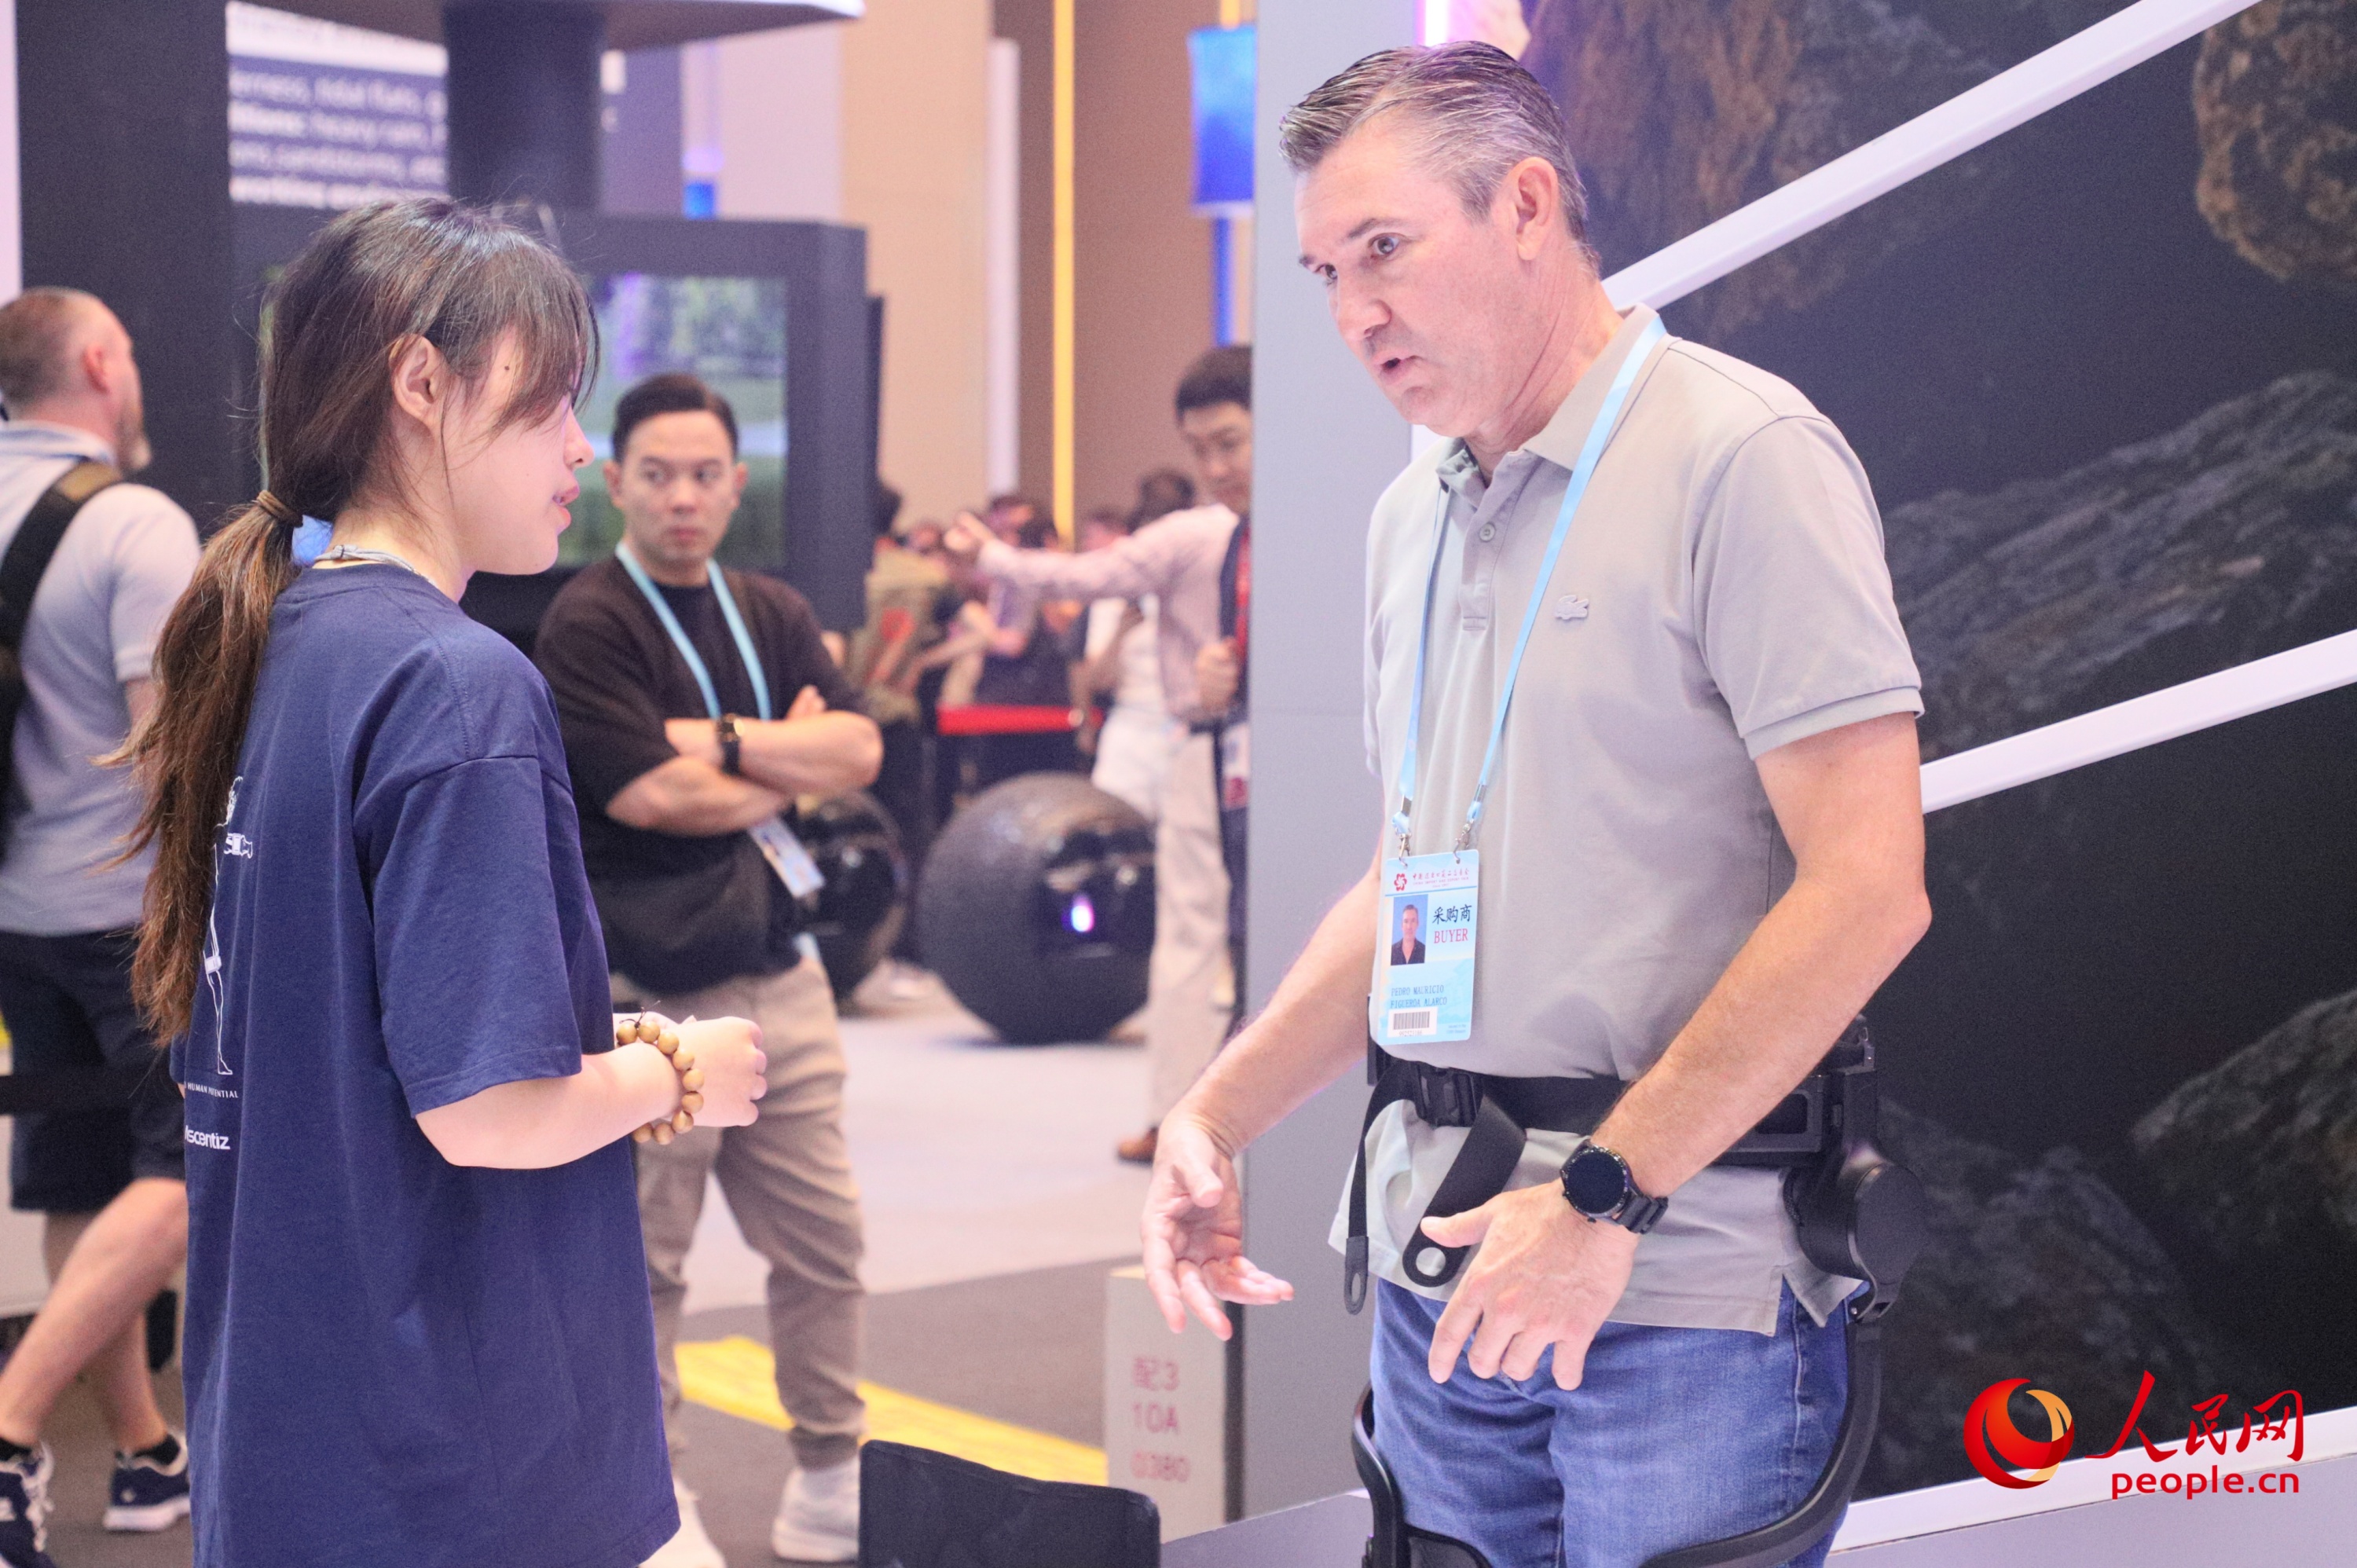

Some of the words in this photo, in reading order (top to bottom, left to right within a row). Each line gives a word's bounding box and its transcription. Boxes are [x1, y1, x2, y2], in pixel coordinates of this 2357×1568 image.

[1431, 904, 1472, 925] 采购商
[1433, 928, 1468, 944] BUYER
[1391, 987, 1410, 997] PEDRO
[1413, 984, 1444, 995] MAURICIO
[1390, 998, 1420, 1009] FIGUEROA
[1424, 997, 1447, 1007] ALARCO
[187, 1082, 207, 1094] HUMAN
